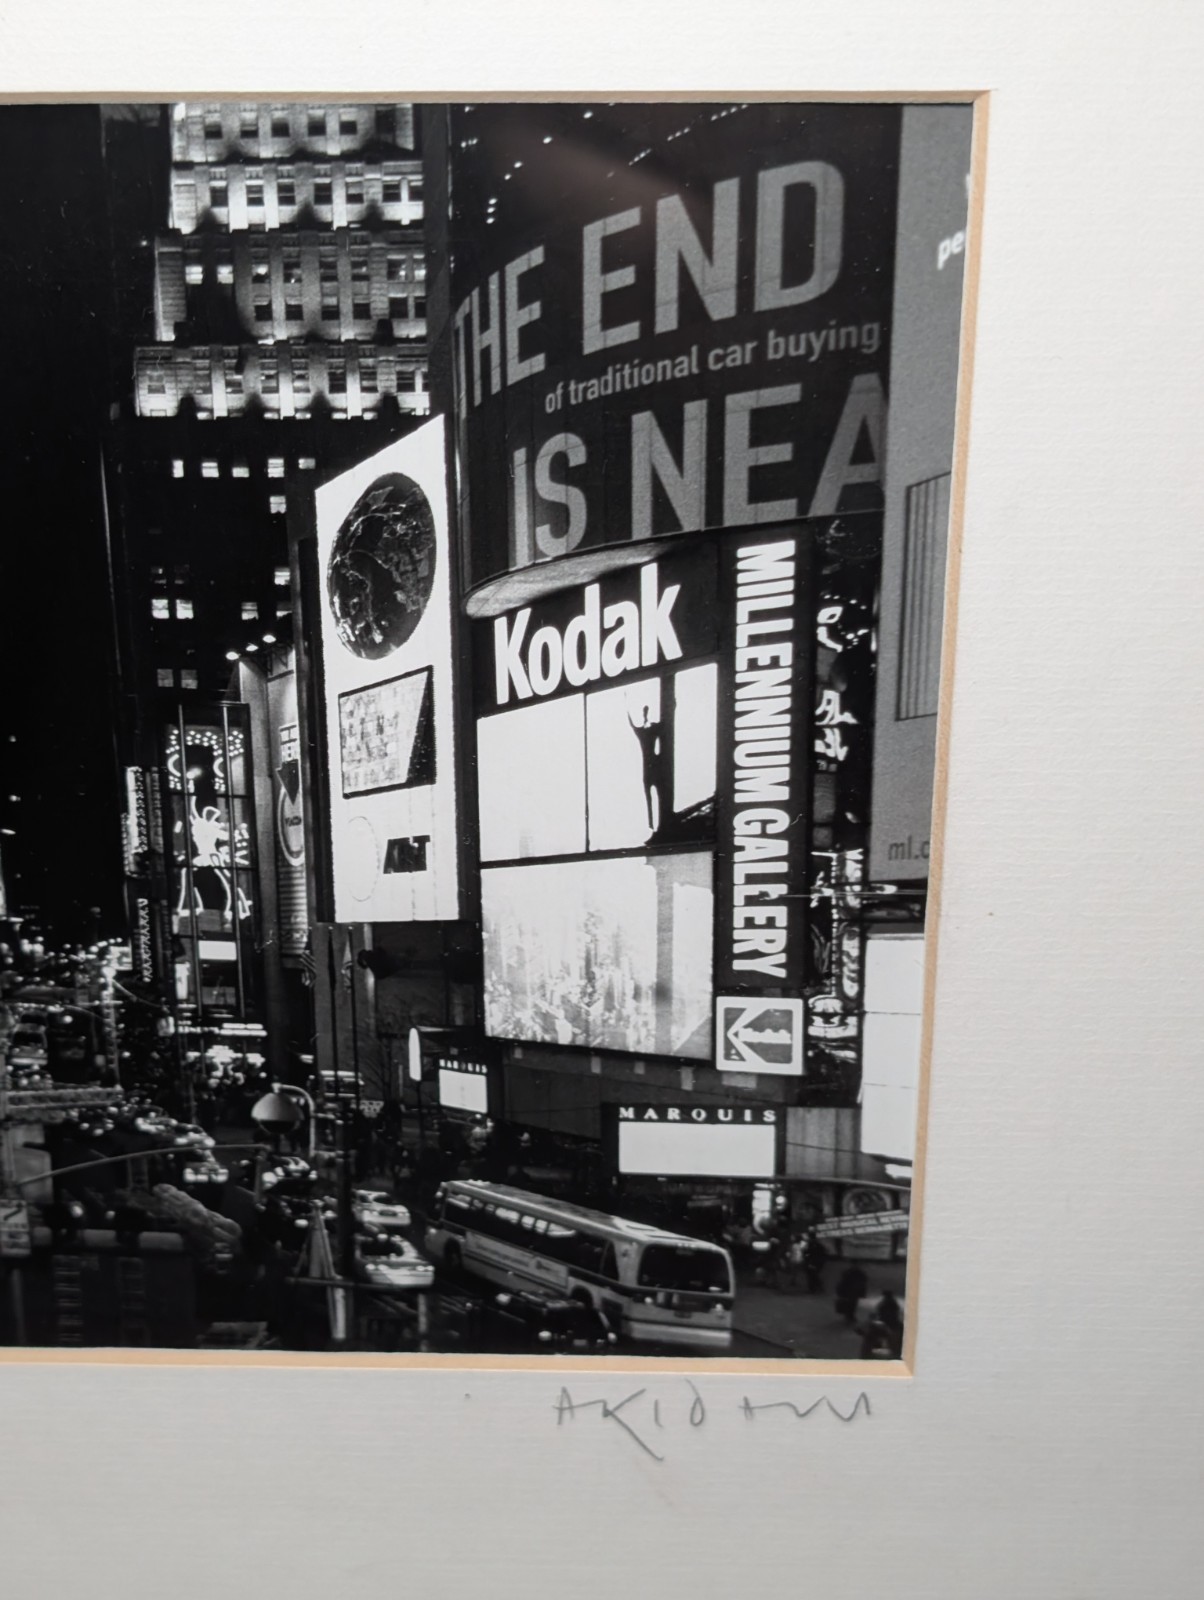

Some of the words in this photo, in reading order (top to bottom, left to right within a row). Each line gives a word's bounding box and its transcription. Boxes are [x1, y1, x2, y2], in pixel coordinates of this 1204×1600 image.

[453, 244, 546, 421] THE
[582, 160, 844, 356] END
[544, 381, 567, 414] of
[568, 345, 700, 409] traditional
[708, 337, 759, 372] car
[767, 319, 881, 362] buying
[510, 432, 587, 571] IS
[630, 371, 887, 541] NEA
[494, 562, 683, 705] Kodak
[734, 540, 796, 803] MILLENNIUM
[732, 807, 791, 979] GALLERY
[618, 1106, 777, 1123] MARQUIS
